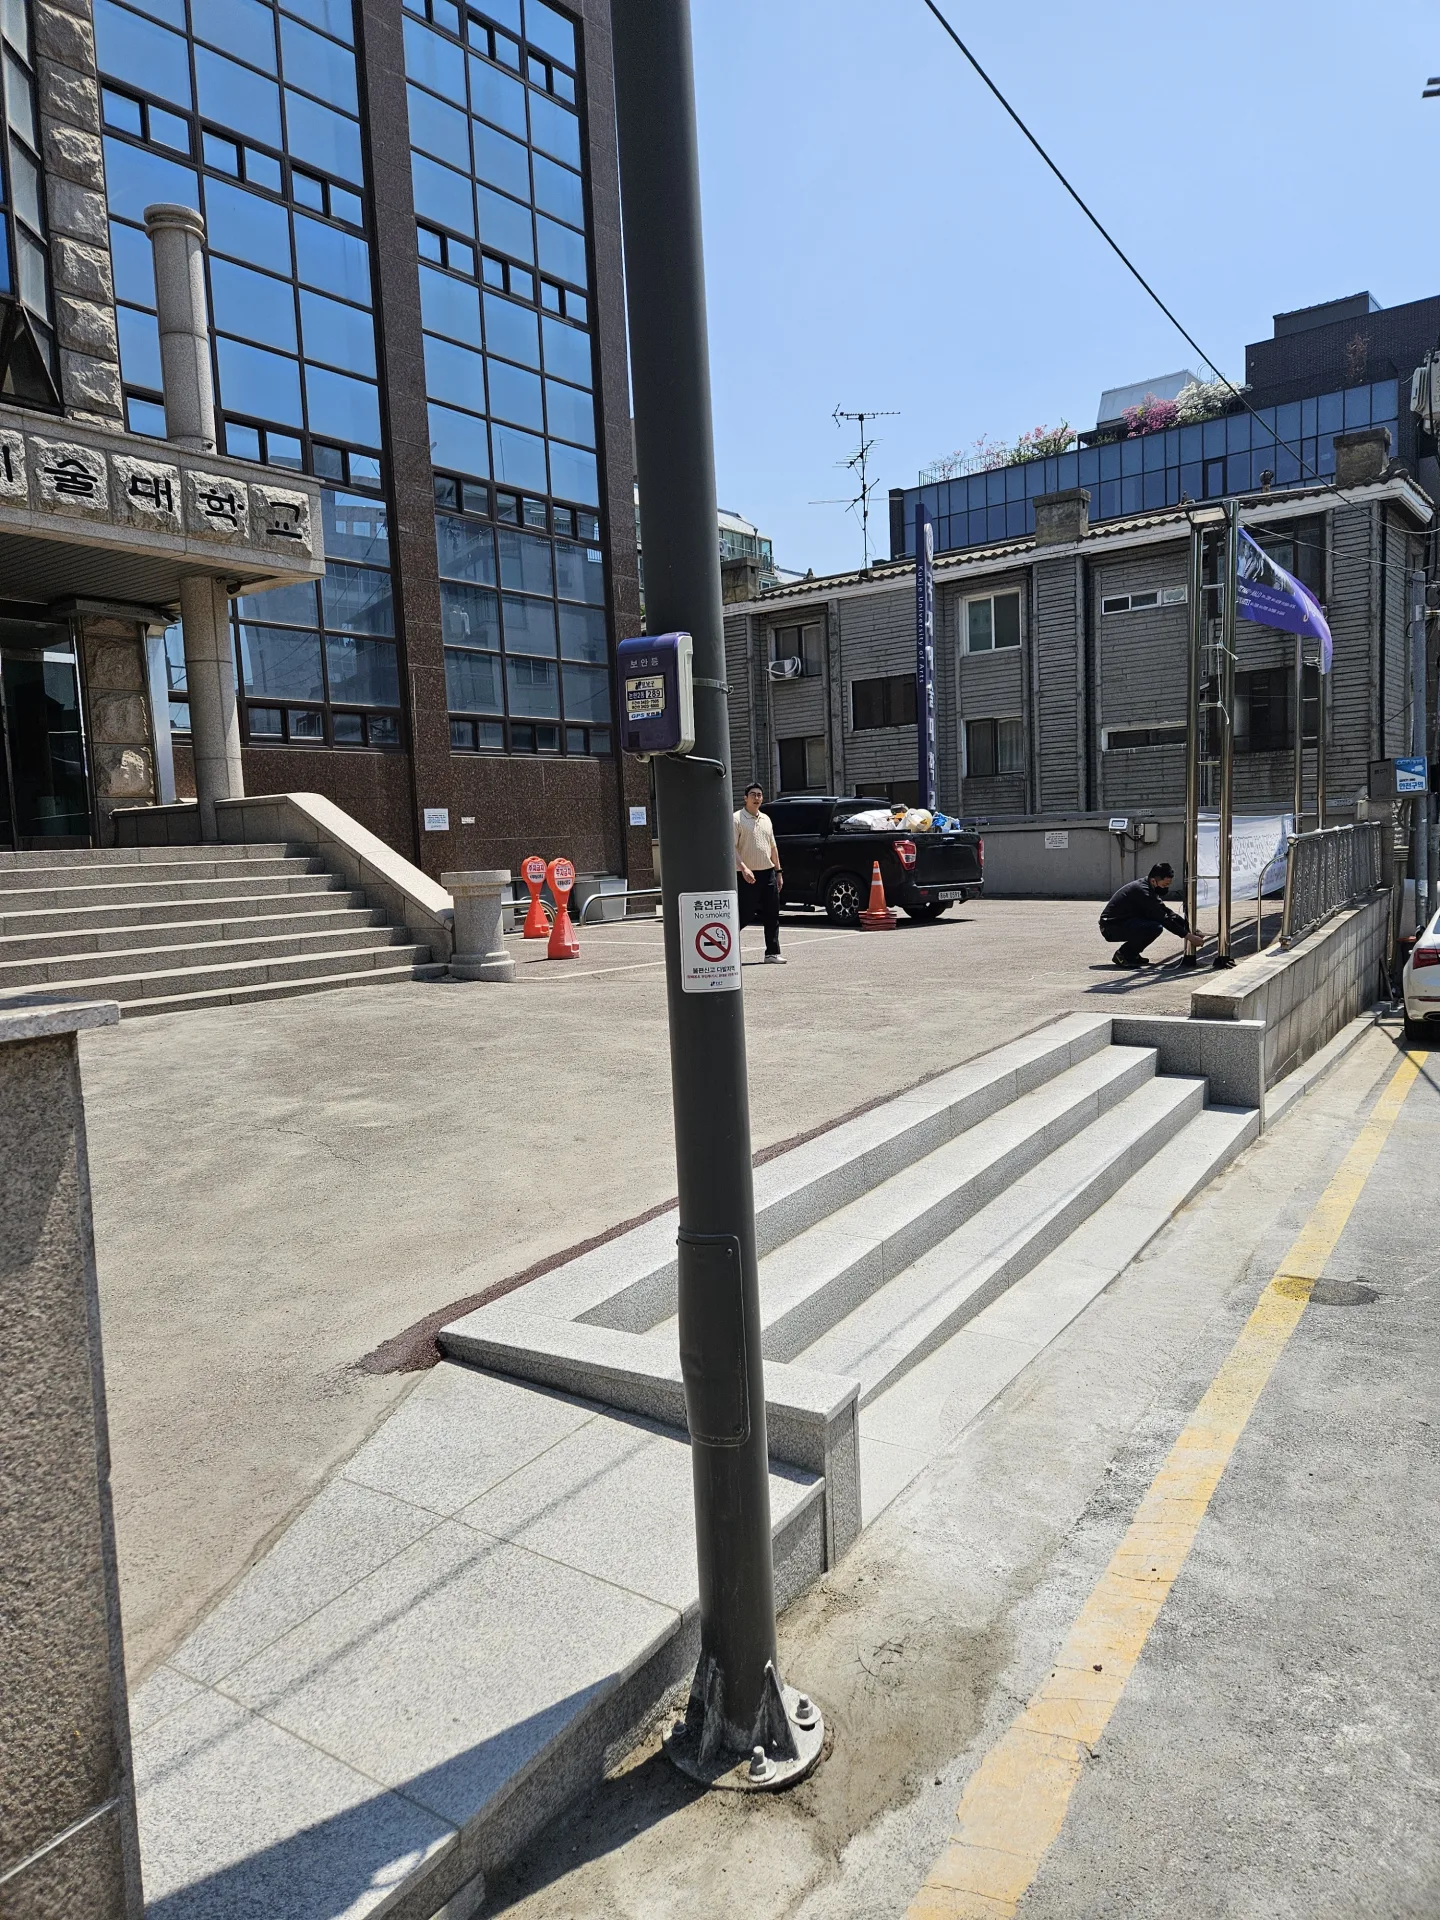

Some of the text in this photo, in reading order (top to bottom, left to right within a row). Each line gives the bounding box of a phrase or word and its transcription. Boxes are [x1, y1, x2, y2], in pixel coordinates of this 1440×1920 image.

[647, 689, 661, 698] 289
[555, 866, 572, 877] 주차금지
[693, 899, 730, 911] 흡연금지
[705, 911, 731, 919] smoking
